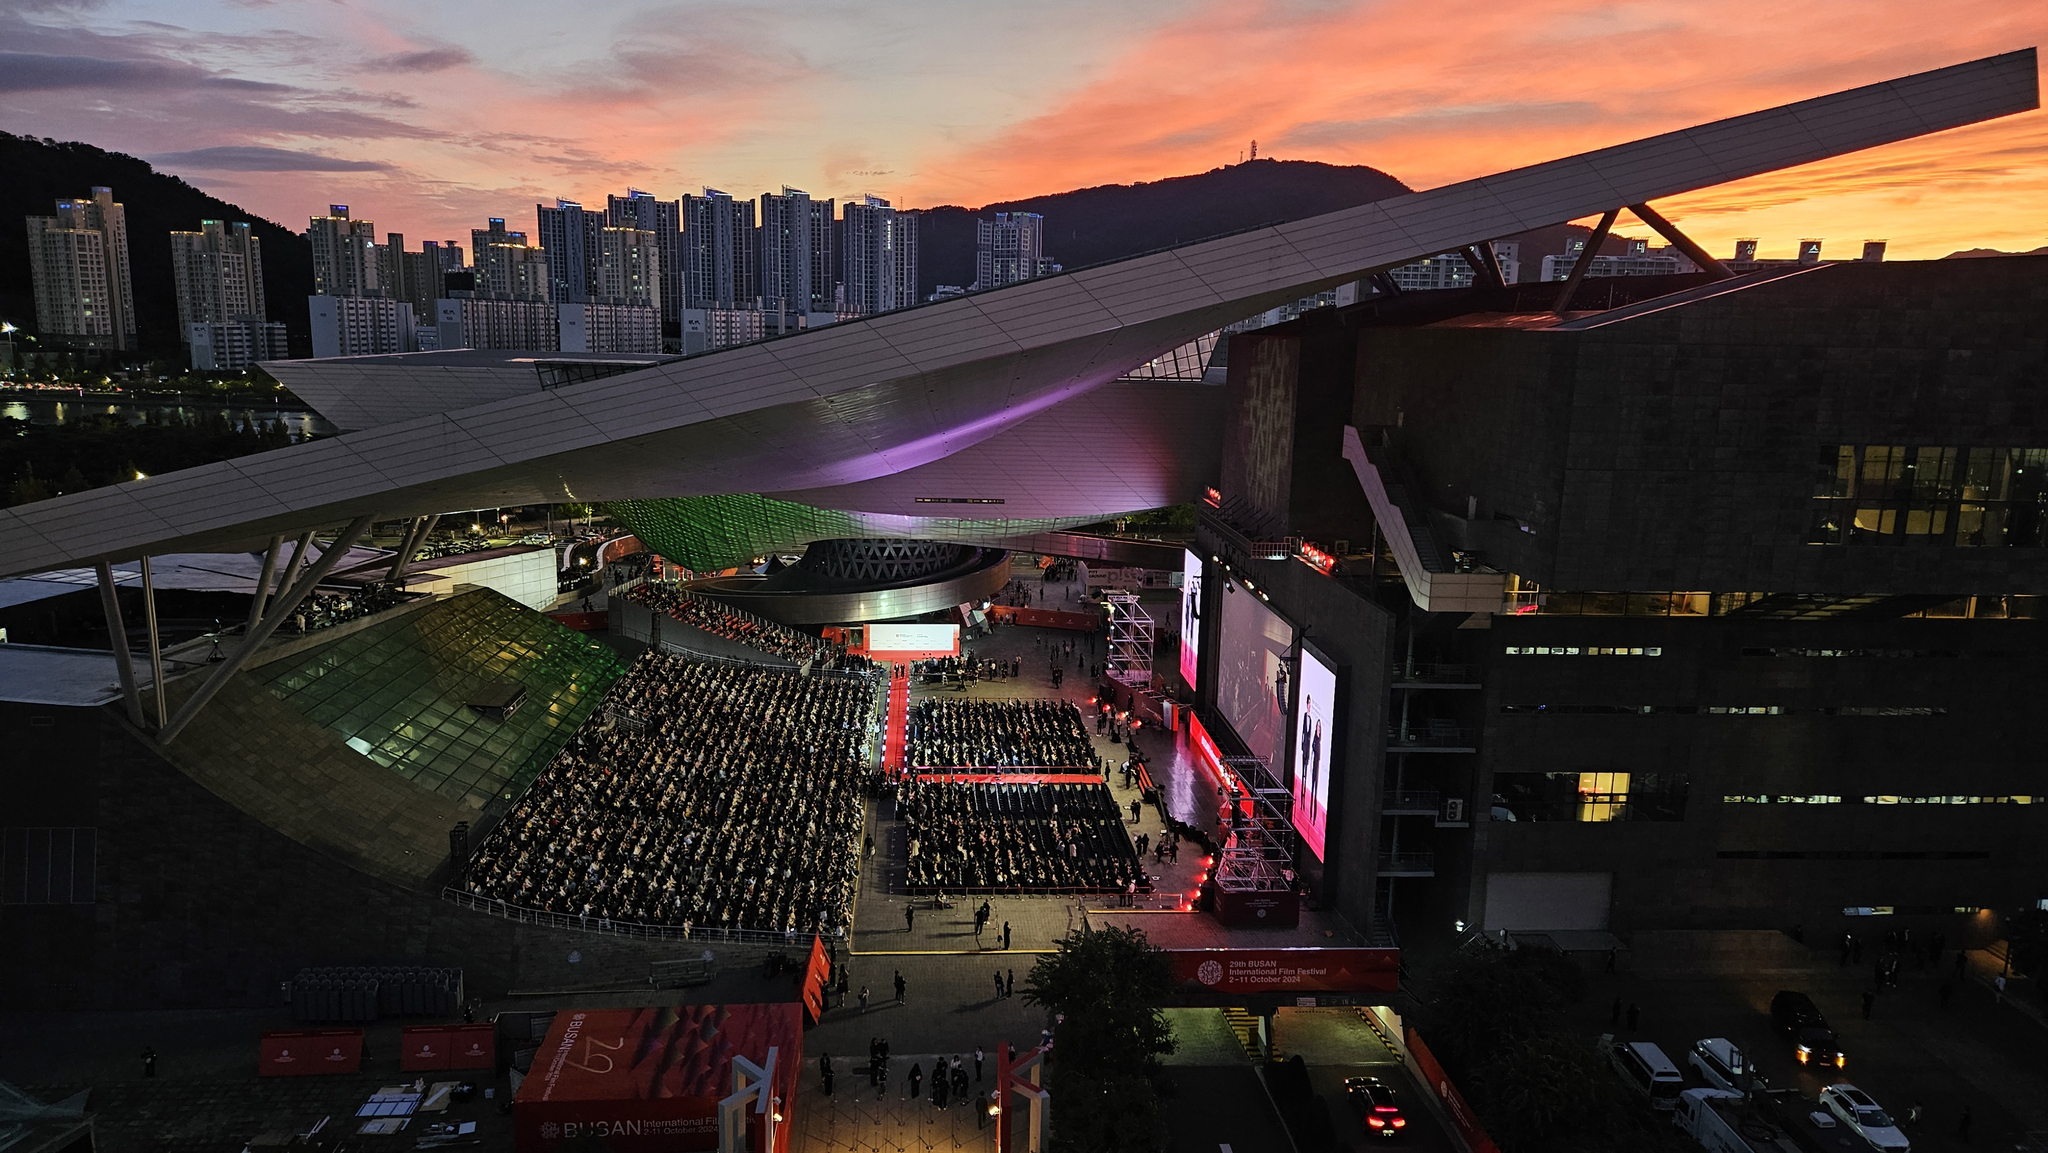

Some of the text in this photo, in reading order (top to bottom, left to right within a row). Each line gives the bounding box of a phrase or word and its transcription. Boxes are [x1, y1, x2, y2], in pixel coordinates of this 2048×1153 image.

[1229, 960, 1277, 968] 29th BUSAN
[1229, 967, 1327, 975] International Film Festival
[1250, 975, 1280, 983] October
[1282, 975, 1301, 983] 2024
[558, 1020, 583, 1050] BUSAN
[643, 1118, 704, 1128] International
[705, 1116, 719, 1125] Fil
[643, 1125, 719, 1136] 2-11 October 2024
